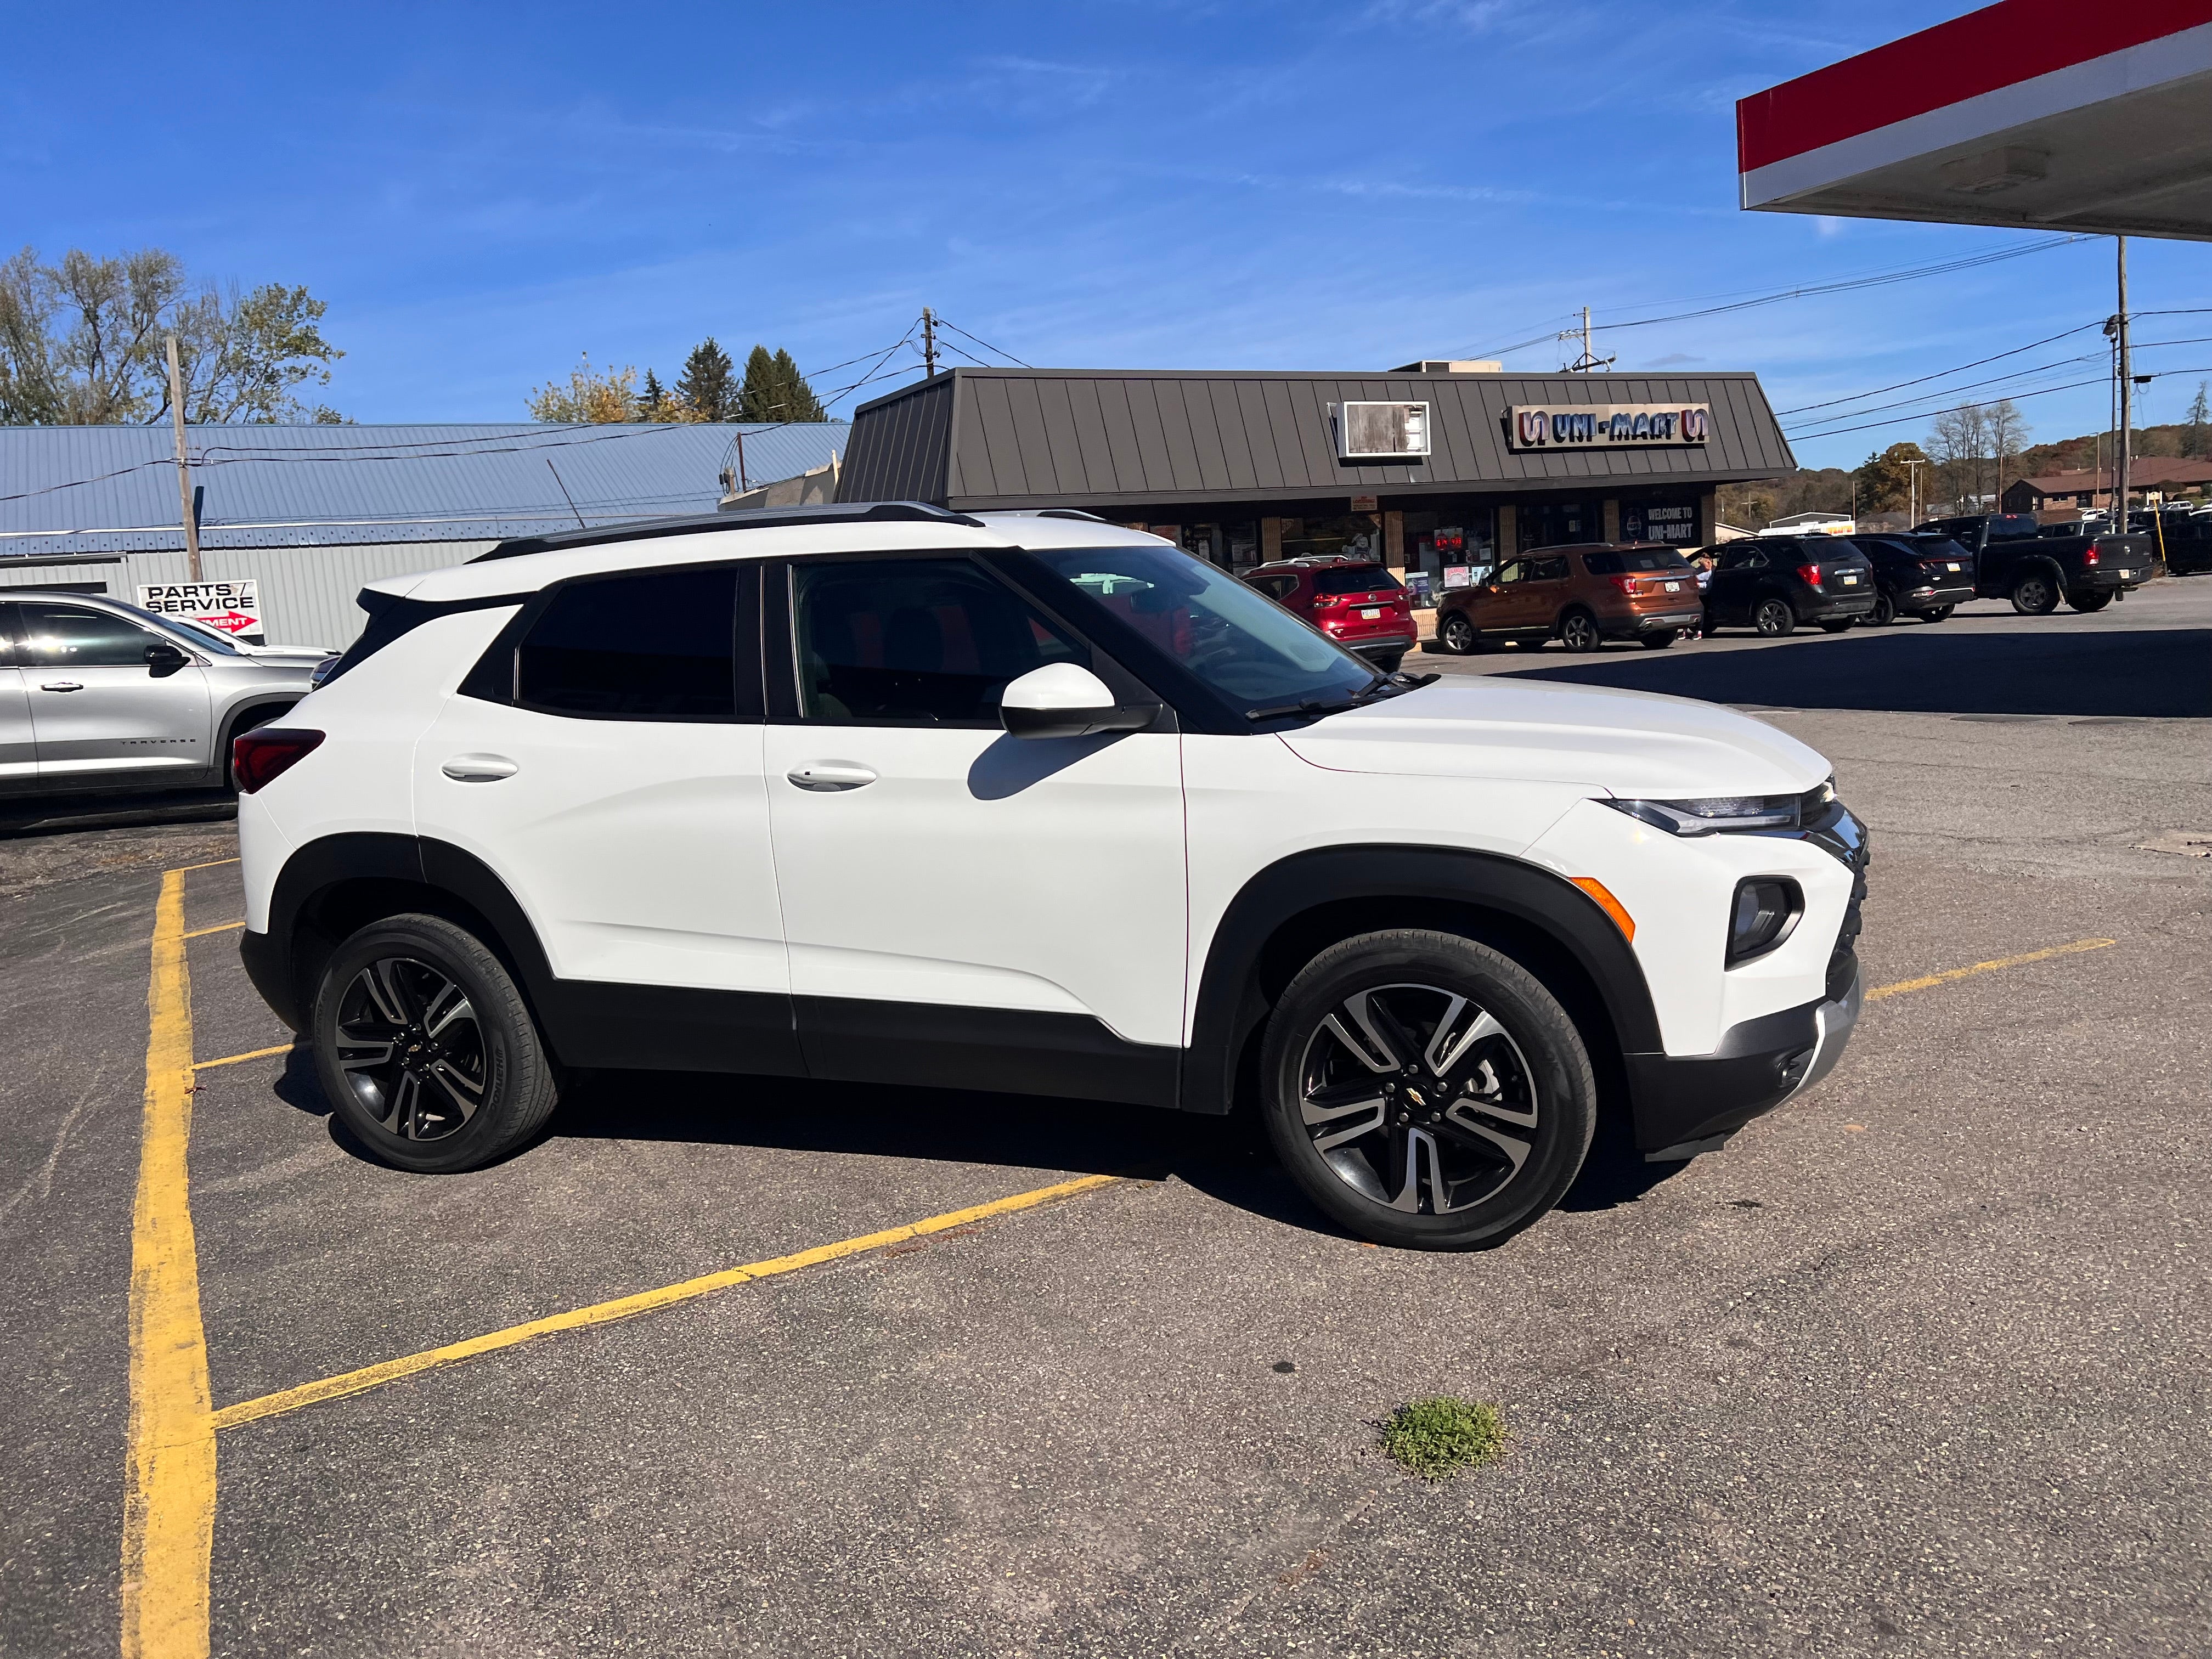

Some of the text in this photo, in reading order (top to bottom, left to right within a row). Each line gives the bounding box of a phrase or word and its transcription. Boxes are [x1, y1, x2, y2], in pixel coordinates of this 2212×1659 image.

[1648, 506, 1693, 520] WELCOME TO
[1648, 523, 1693, 540] UNI-MART
[145, 596, 255, 613] SERVICE
[205, 617, 247, 627] MENT
